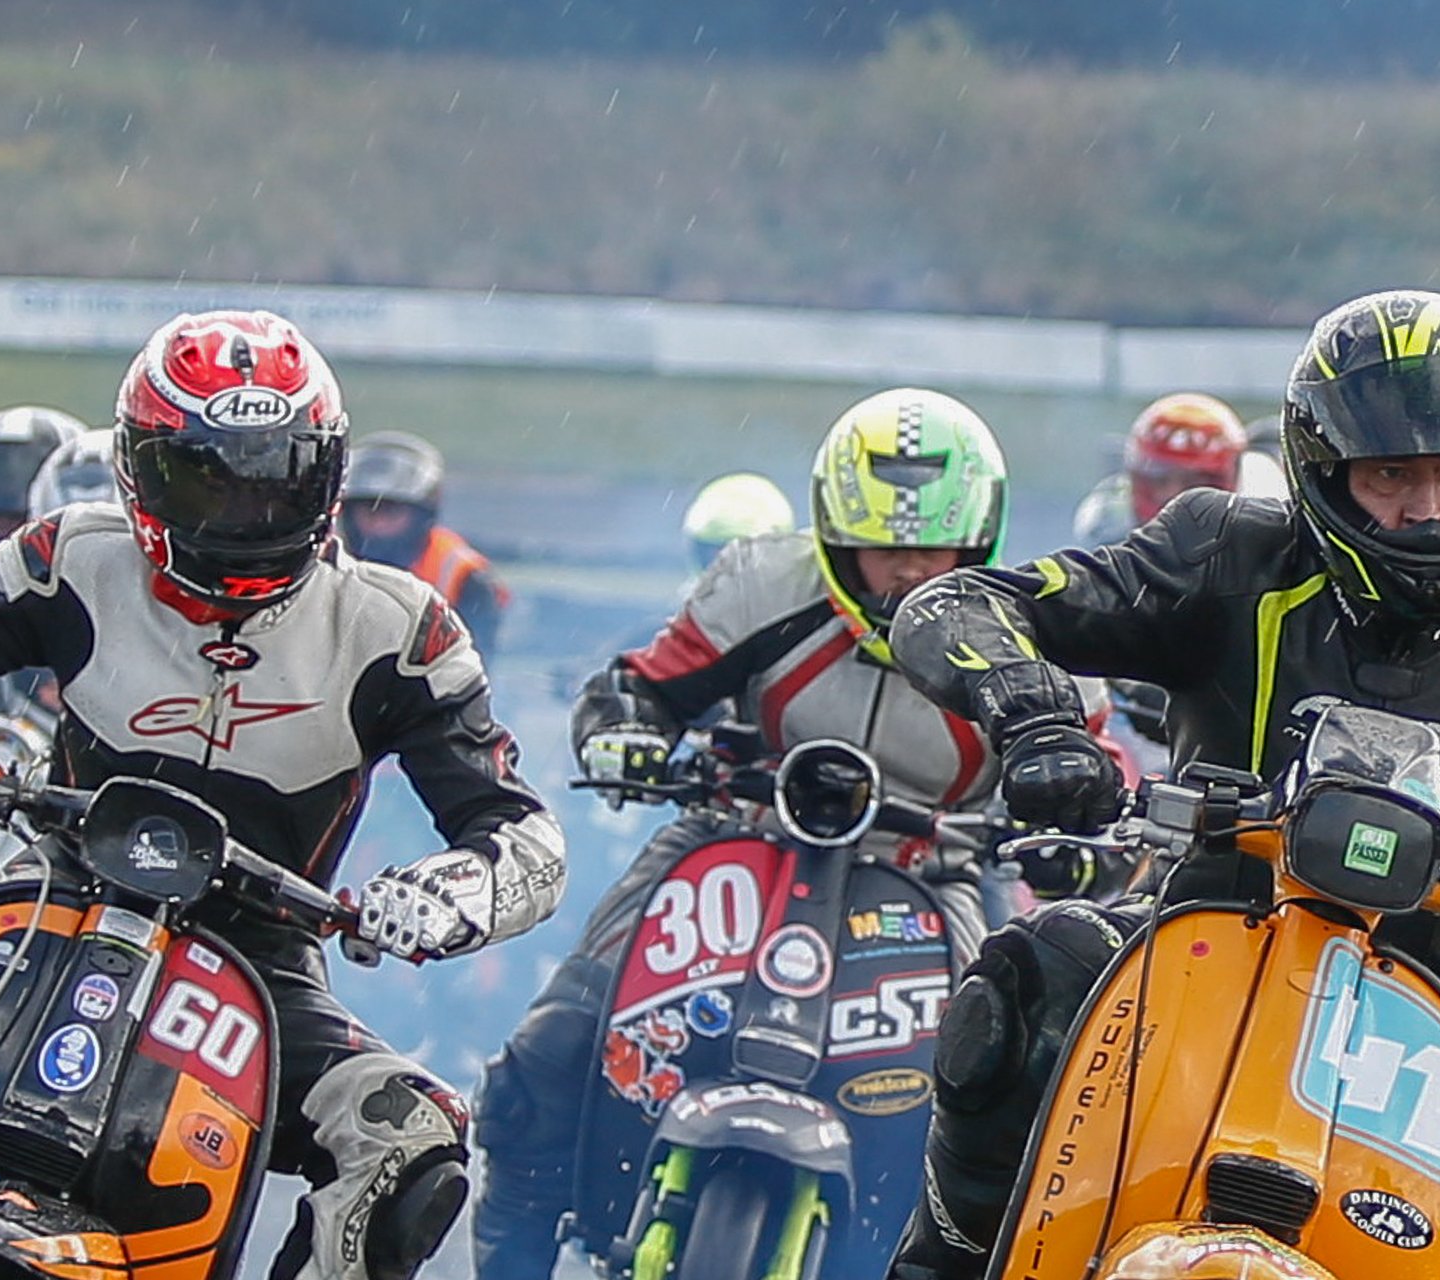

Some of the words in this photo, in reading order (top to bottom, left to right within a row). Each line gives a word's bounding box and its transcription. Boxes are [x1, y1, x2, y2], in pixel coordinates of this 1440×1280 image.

[213, 393, 281, 422] Arai
[644, 862, 762, 974] 30
[848, 910, 946, 943] MERU
[148, 978, 261, 1079] 60
[194, 1126, 224, 1153] JB
[1344, 1206, 1396, 1245] SCOOTER
[1396, 1234, 1427, 1248] CLUB
[1349, 1191, 1430, 1235] DARLINGTON
